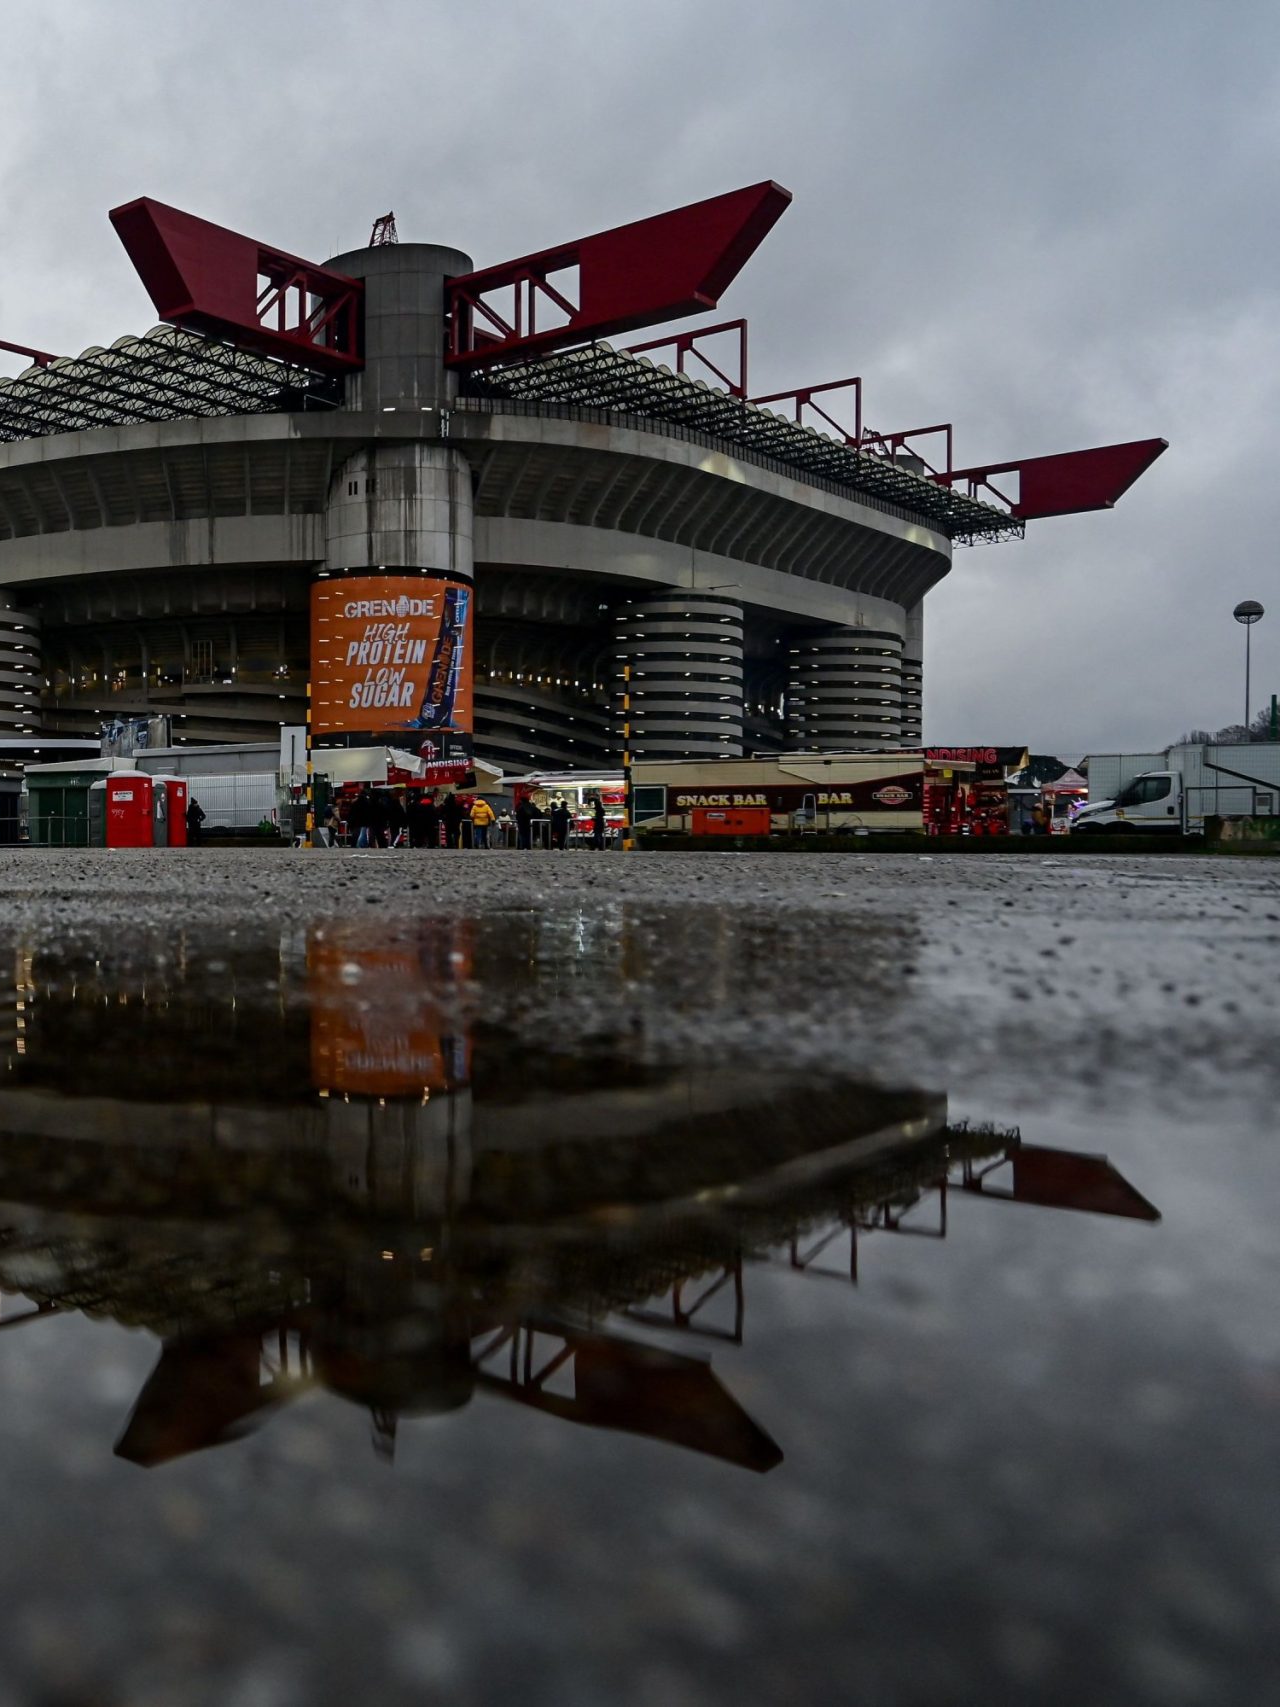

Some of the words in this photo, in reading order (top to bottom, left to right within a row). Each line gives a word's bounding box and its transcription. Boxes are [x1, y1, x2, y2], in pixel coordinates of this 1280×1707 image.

[363, 622, 410, 642] HIGH
[345, 639, 427, 666] PROTEIN
[364, 667, 406, 686] LOW
[349, 681, 415, 709] SUGAR
[425, 758, 469, 769] ANDISING
[926, 748, 997, 764] NDISING
[676, 795, 731, 806] SNACK
[733, 794, 767, 805] BAR
[817, 792, 854, 804] BAR
